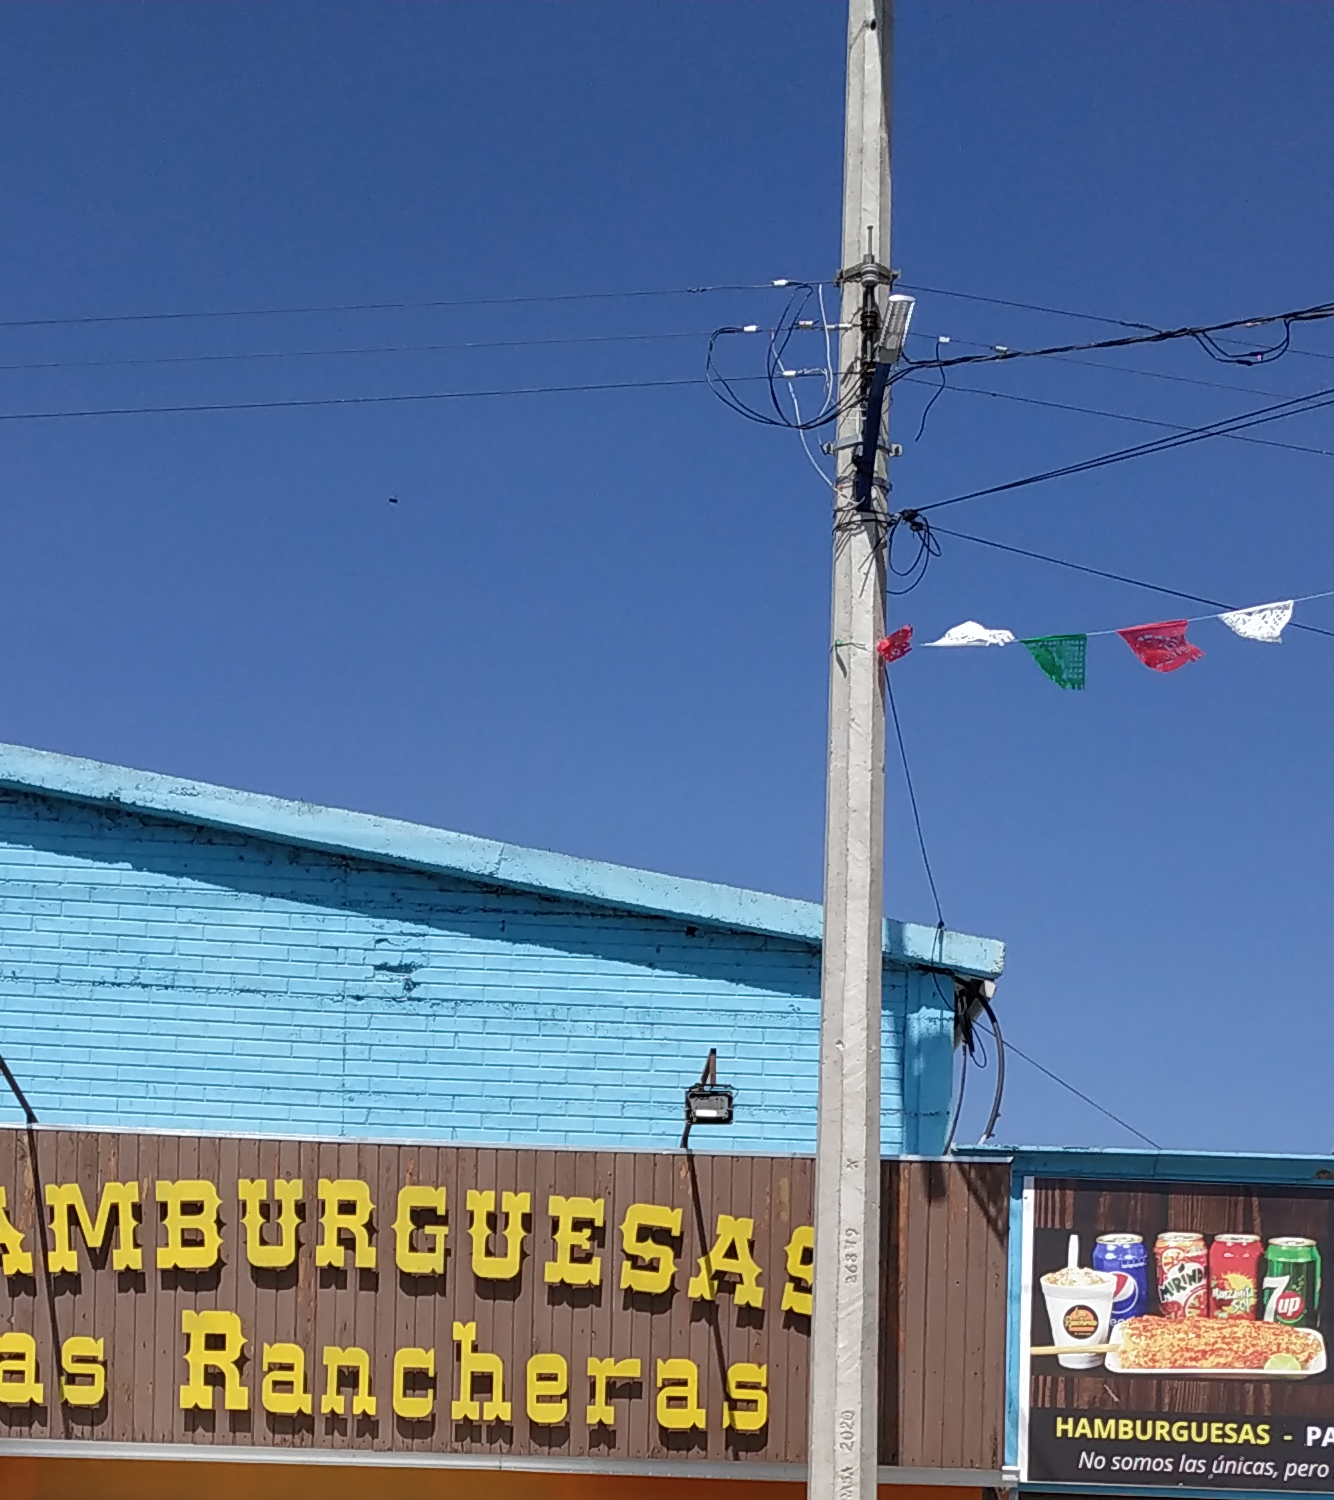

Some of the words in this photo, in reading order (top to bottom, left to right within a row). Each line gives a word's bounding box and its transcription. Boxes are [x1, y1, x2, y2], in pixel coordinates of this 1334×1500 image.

[179, 1309, 767, 1430] Rancheras
[839, 1409, 856, 1452] 2020
[1056, 1416, 1271, 1445] HAMBURGUESAS
[1078, 1450, 1106, 1470] No
[1111, 1455, 1174, 1473] somos
[1179, 1453, 1207, 1474] las
[1211, 1454, 1278, 1479] únicas,
[1284, 1461, 1329, 1482] pero
